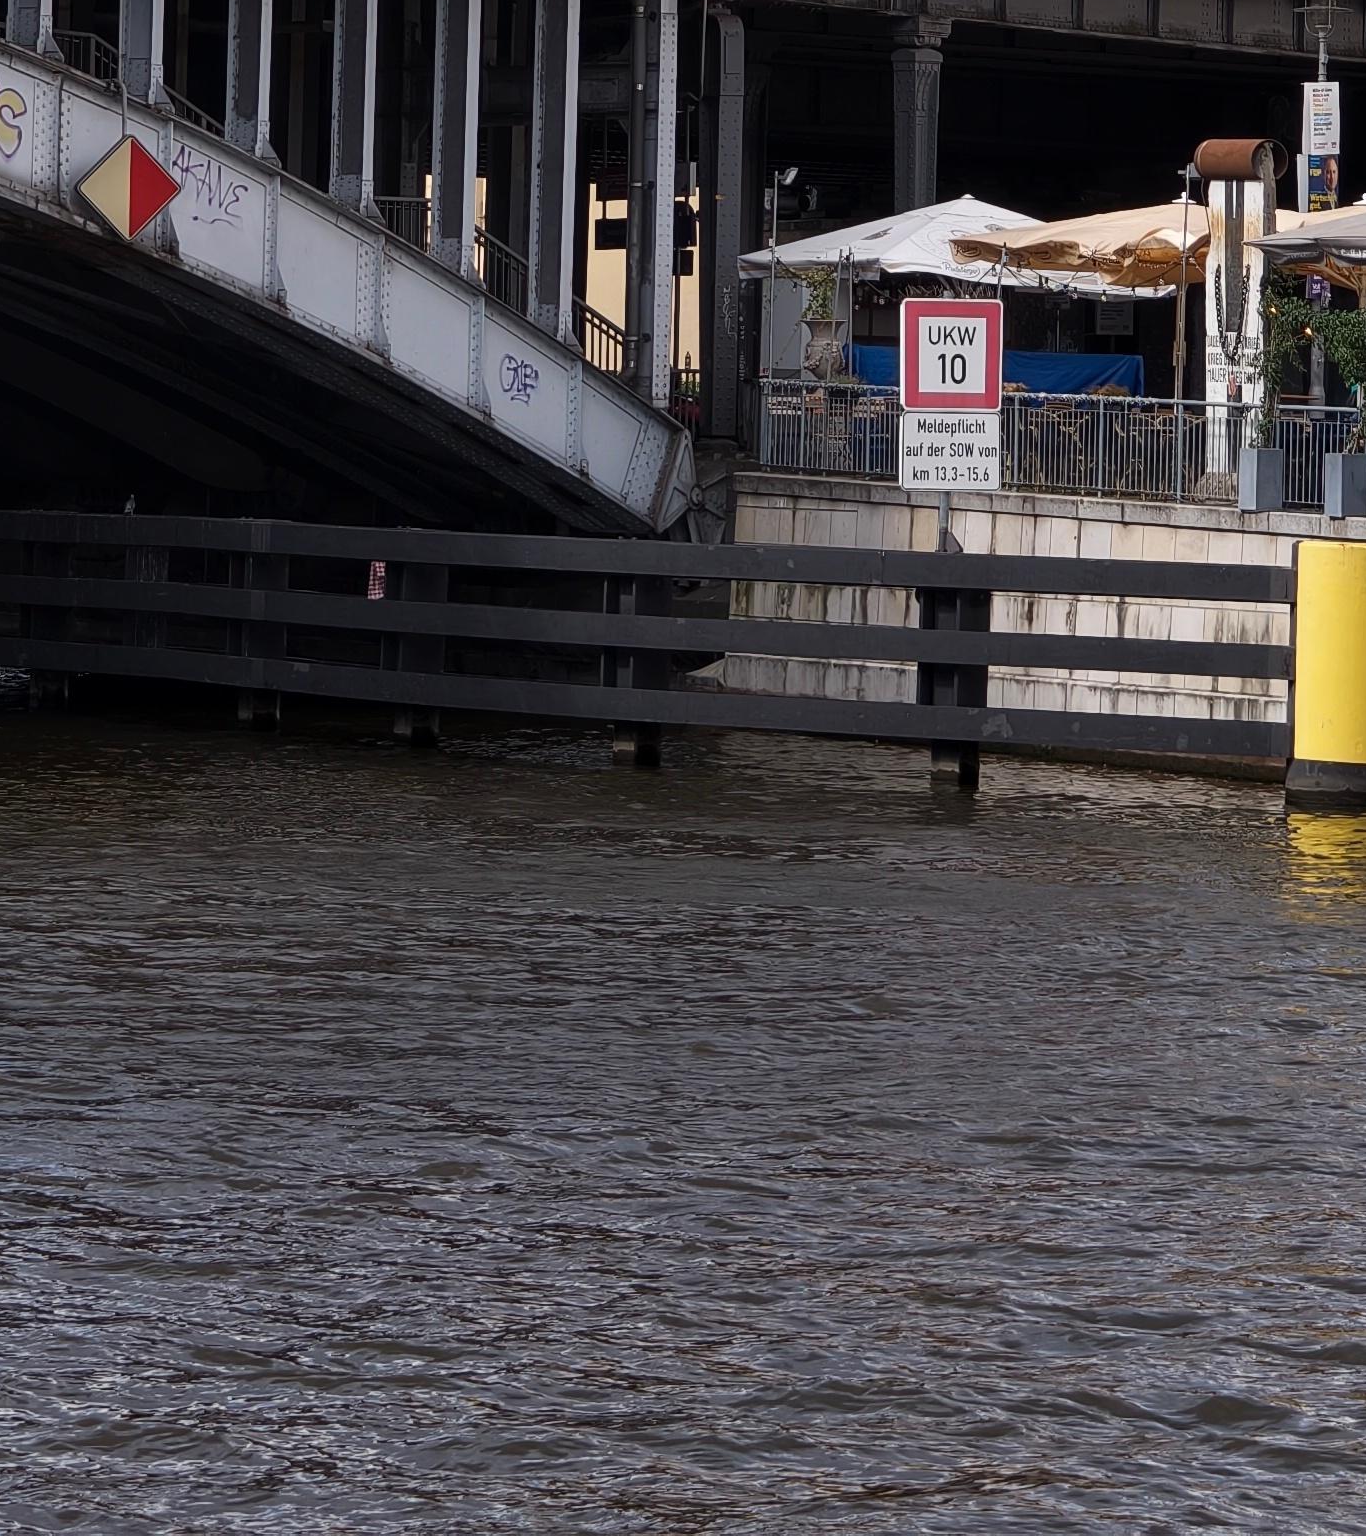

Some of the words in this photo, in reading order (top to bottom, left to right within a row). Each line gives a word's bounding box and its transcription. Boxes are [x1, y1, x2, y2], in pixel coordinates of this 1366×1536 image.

[928, 325, 977, 346] UKW
[937, 353, 967, 385] 10
[917, 418, 986, 437] Meldepflicht
[906, 442, 923, 457] auf
[927, 442, 945, 457] der
[949, 442, 974, 458] SOW
[978, 446, 997, 458] von
[912, 466, 929, 481] km
